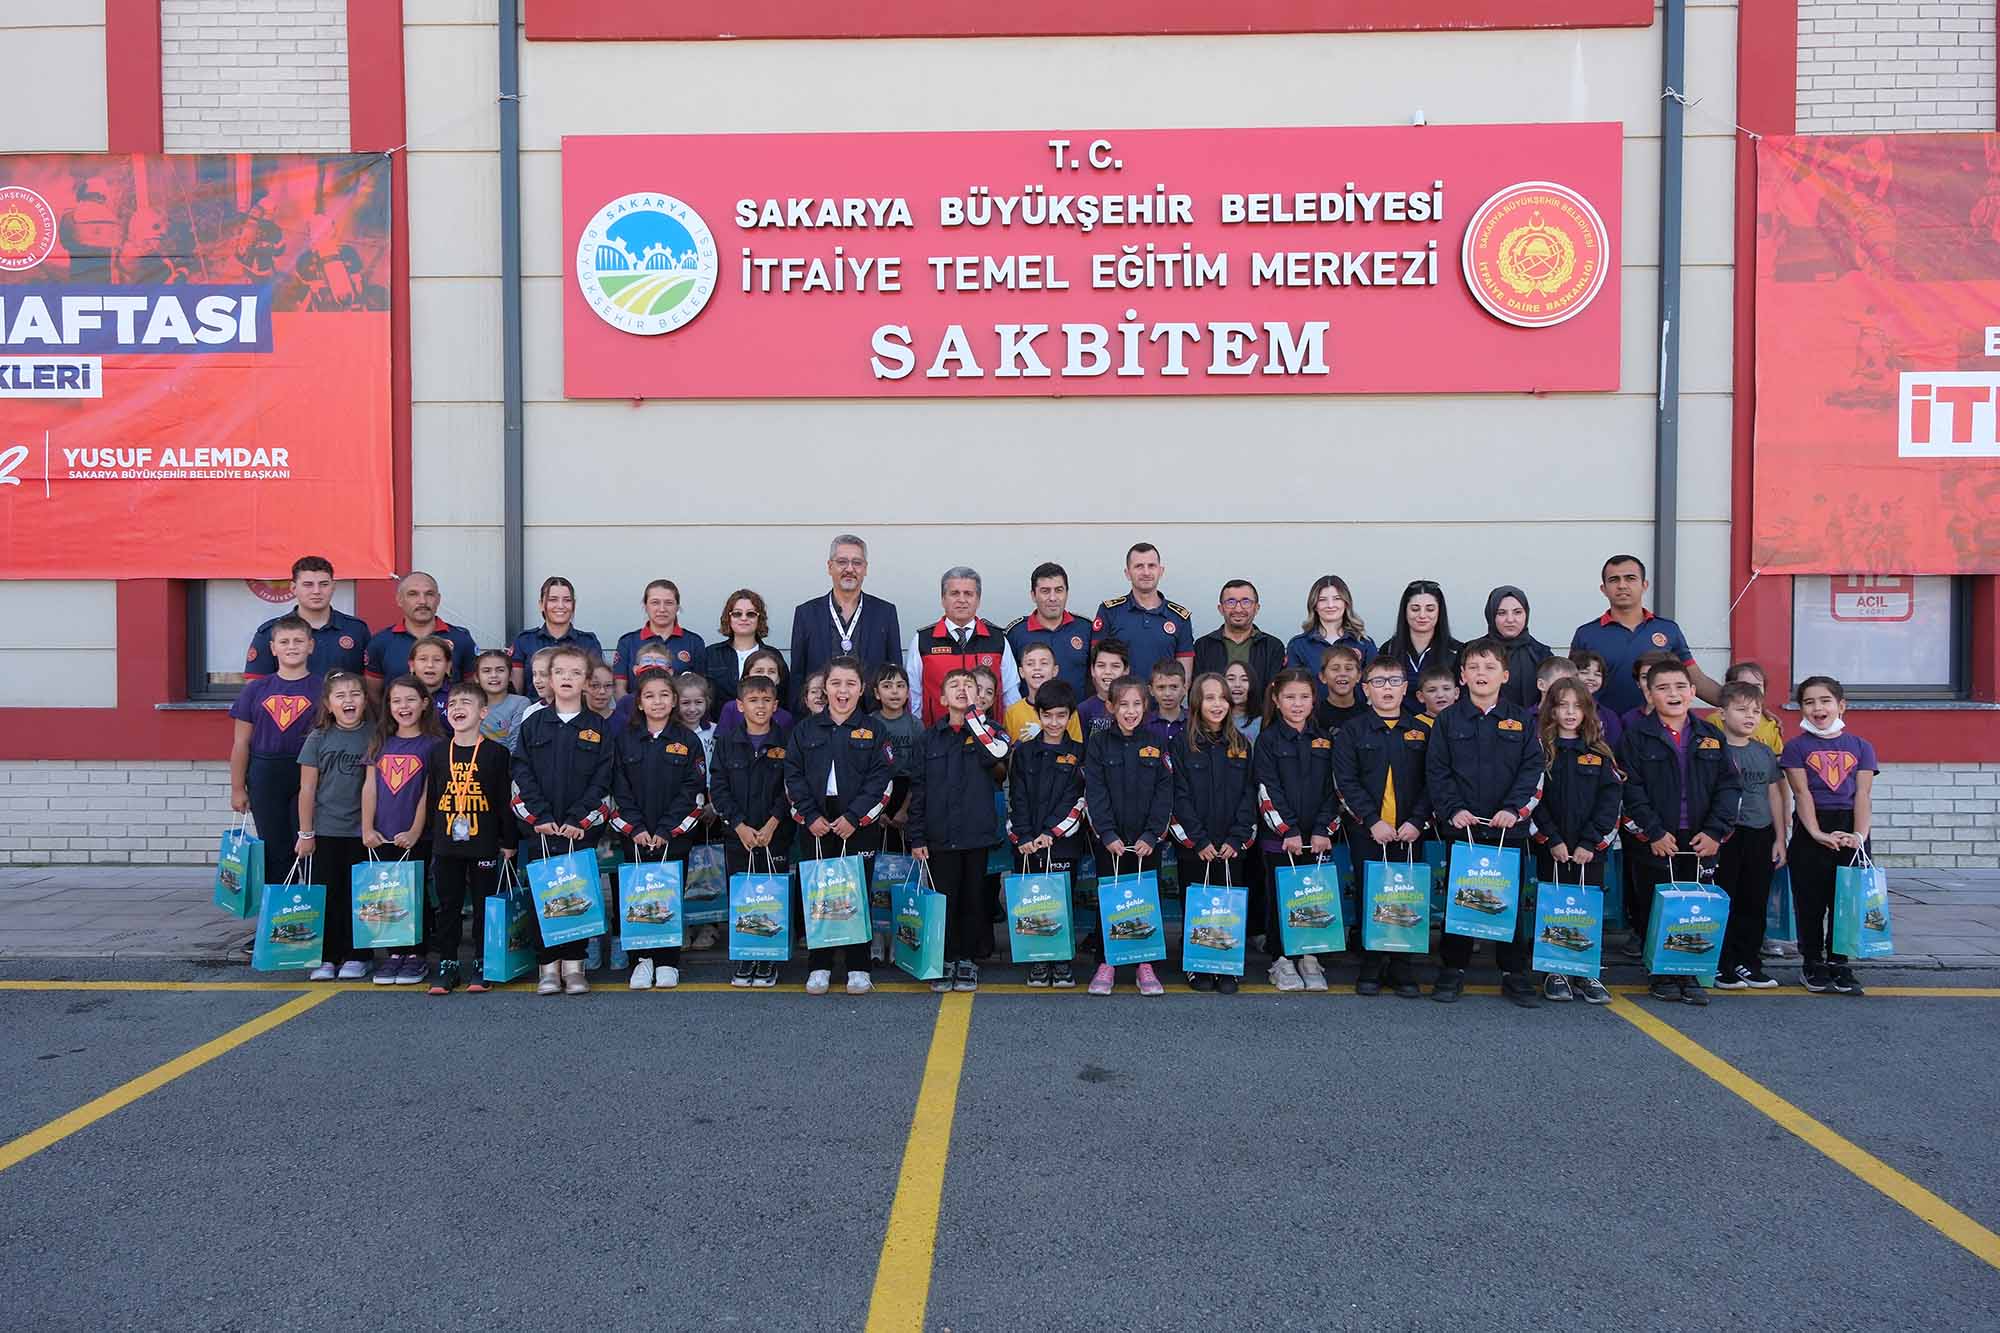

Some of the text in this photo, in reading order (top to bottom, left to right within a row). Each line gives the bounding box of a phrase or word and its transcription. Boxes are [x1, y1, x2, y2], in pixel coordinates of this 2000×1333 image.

[1049, 140, 1122, 168] T. C.
[606, 198, 687, 219] SAKARYA
[735, 180, 1443, 232] SAKARYA BÜYÜKŞEHİR BELEDİYESİ
[1480, 211, 1504, 249] SAKARYA
[742, 240, 1438, 292] İTFAİYE TEMEL EĞİTİM MERKEZİ
[0, 295, 258, 345] AFTASI
[870, 309, 1330, 379] SAKBİTEM
[63, 447, 289, 468] YUSUF ALEMDAR
[68, 468, 290, 480] SAKARYA BÜYÜKŞEHİR BELEDİYE BAŞKANI
